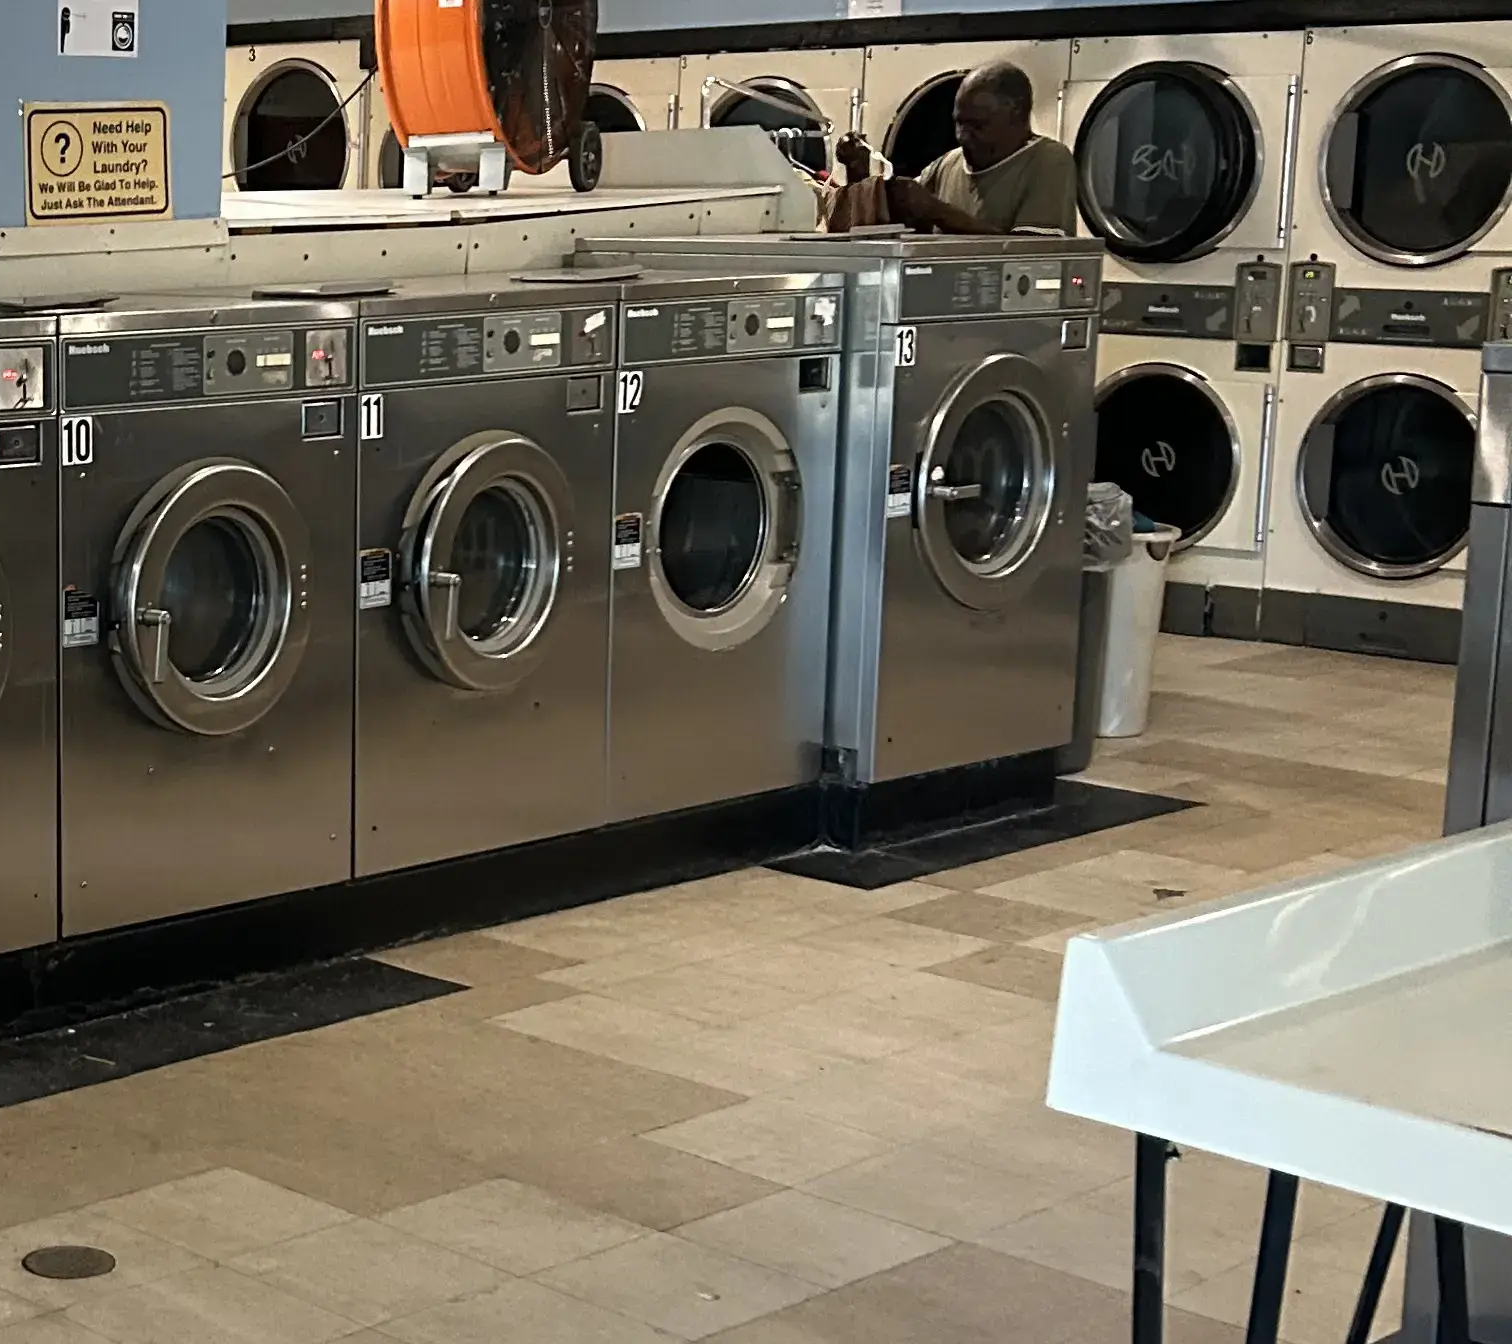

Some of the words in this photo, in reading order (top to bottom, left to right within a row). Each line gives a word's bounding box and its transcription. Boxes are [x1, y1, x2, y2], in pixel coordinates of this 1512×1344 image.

[1306, 30, 1314, 46] 6
[248, 47, 256, 62] 3
[1073, 39, 1080, 54] 5
[93, 121, 122, 134] Need
[126, 120, 152, 136] Help
[92, 141, 118, 154] With
[121, 140, 148, 153] Your
[93, 159, 148, 175] Laundry?
[38, 183, 54, 194] We
[57, 181, 76, 193] Will
[78, 181, 91, 192] Be
[94, 180, 116, 191] Glad
[118, 179, 131, 190] To
[134, 178, 158, 191] Help.
[41, 198, 63, 210] Just
[65, 197, 84, 209] Ask
[87, 197, 105, 208] The
[897, 329, 914, 365] 13
[620, 373, 641, 411] 12
[362, 396, 381, 437] 11
[63, 419, 91, 462] 10
